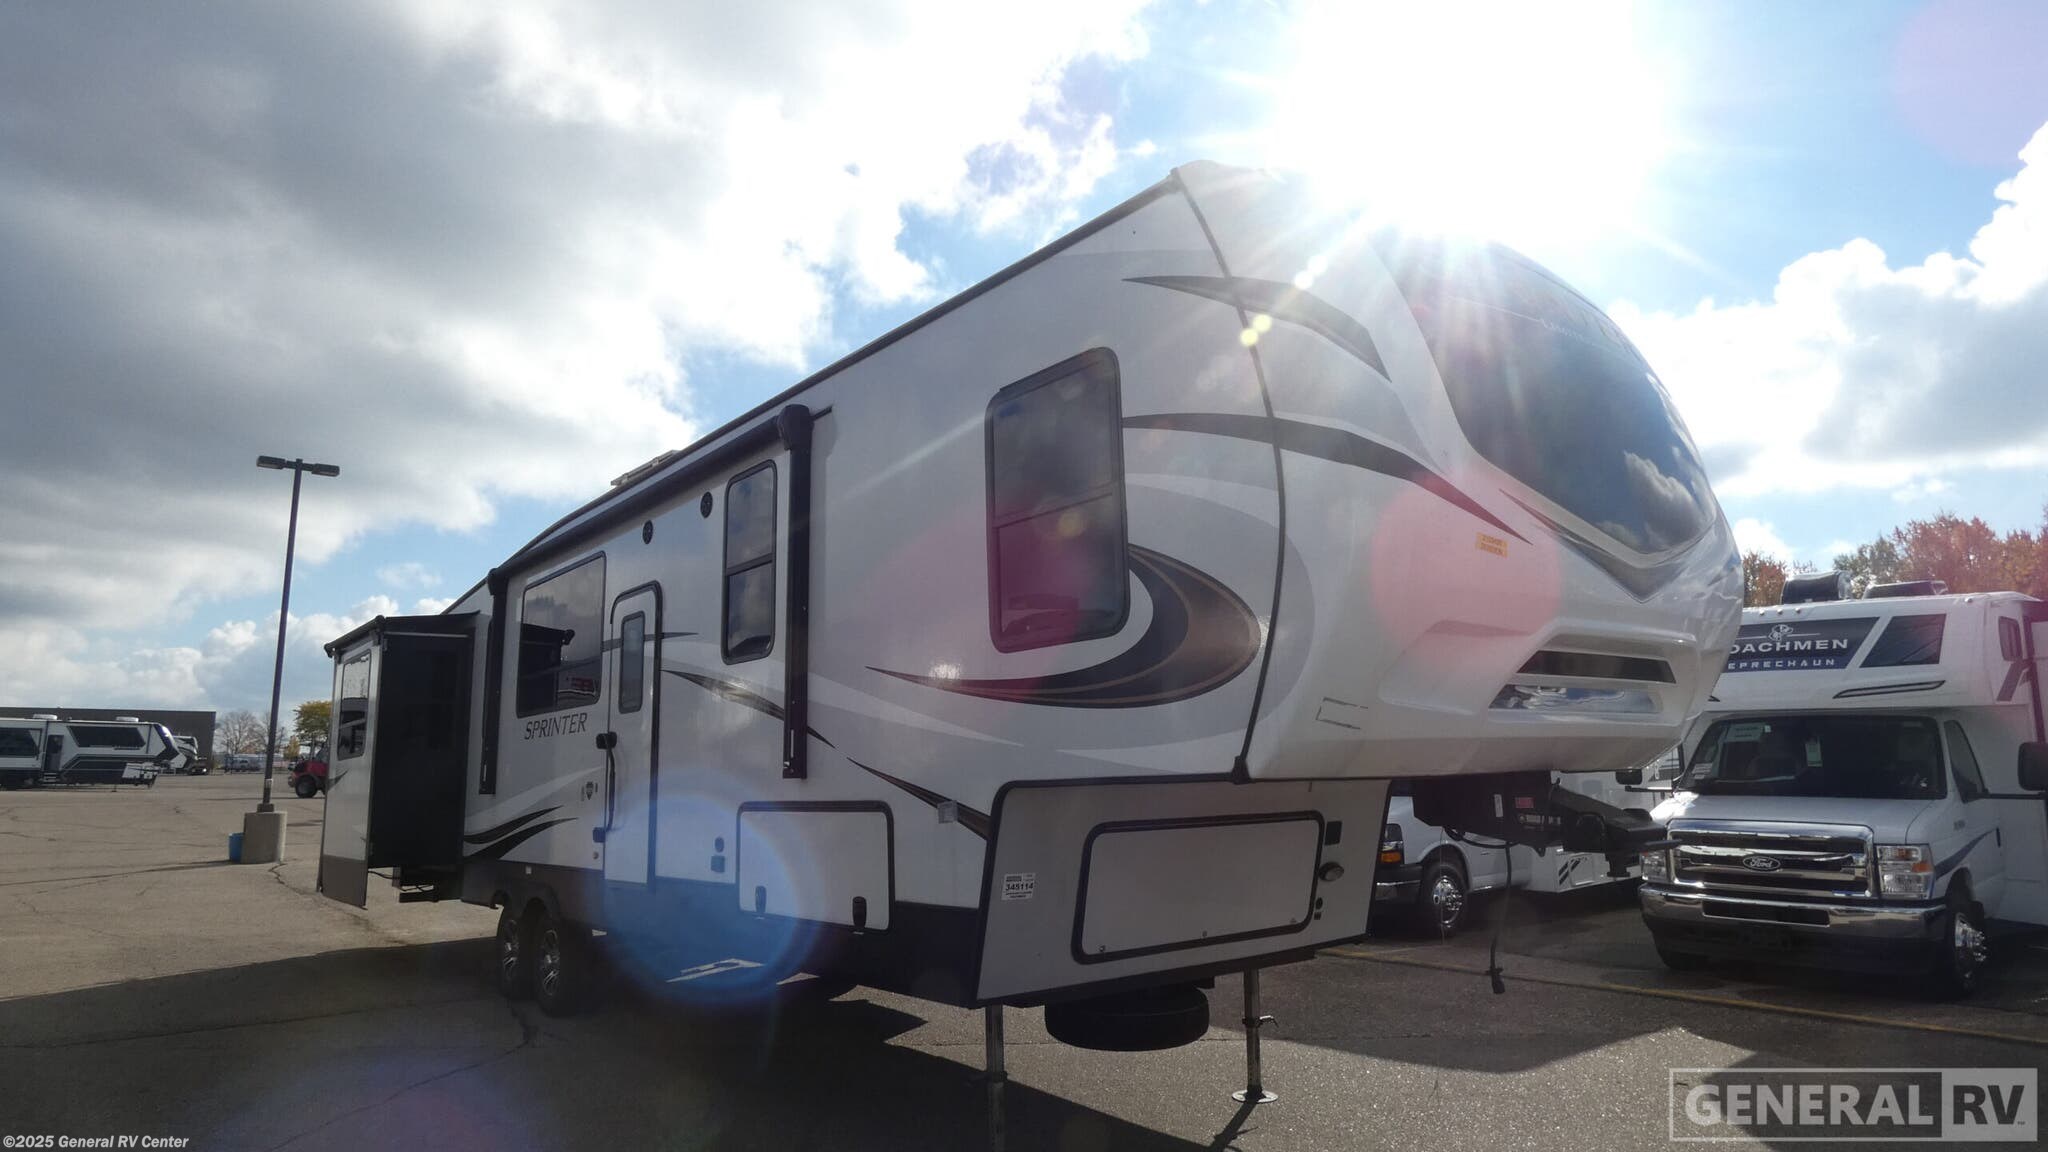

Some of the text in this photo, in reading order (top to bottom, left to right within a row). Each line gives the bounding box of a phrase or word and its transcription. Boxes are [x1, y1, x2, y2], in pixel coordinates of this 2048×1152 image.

[1730, 639, 1848, 654] OACHMEN
[1727, 659, 1835, 670] EPRECHAUN
[524, 712, 588, 740] SPRINTER
